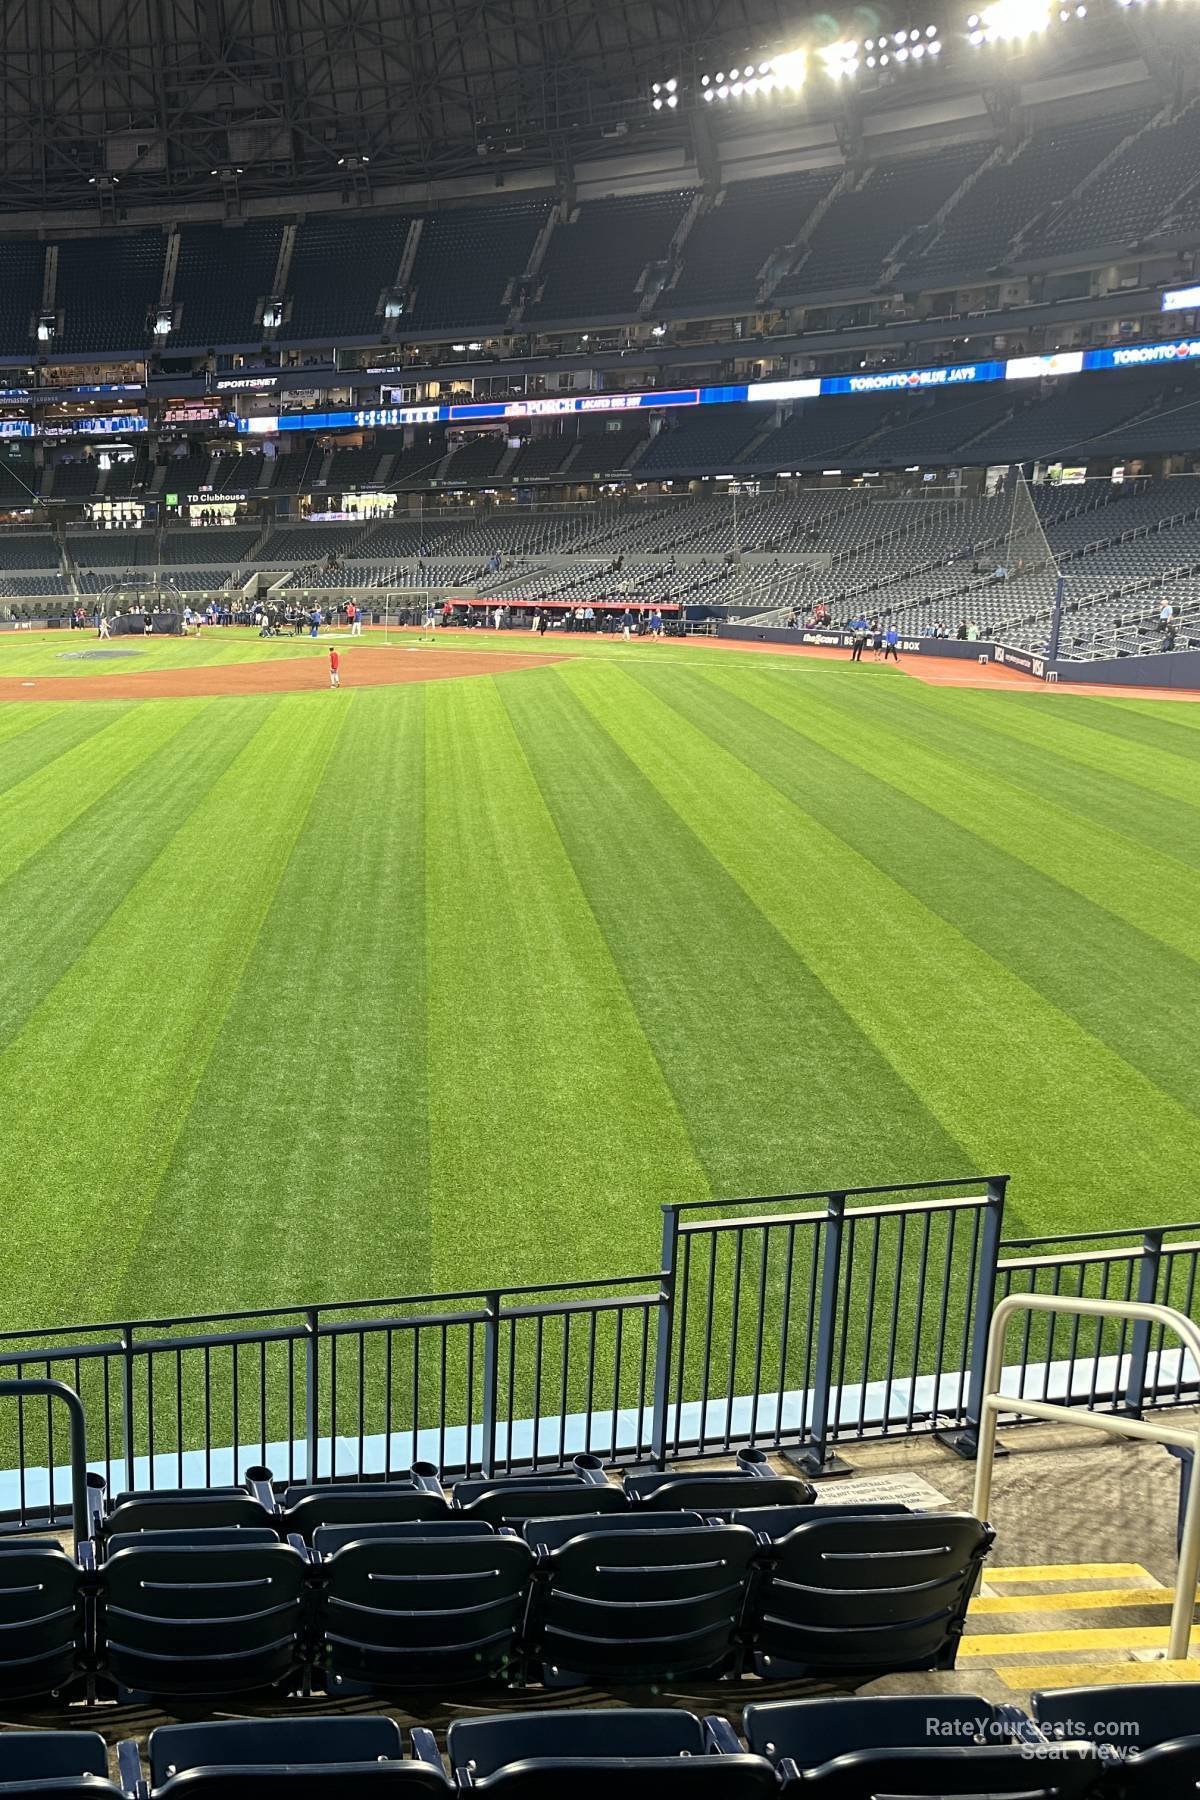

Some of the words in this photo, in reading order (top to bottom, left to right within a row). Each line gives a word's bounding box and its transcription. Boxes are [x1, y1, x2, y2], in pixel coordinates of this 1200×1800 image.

[1113, 345, 1176, 364] TORONTO
[217, 378, 277, 389] SPORTSNET
[849, 374, 908, 391] TORONTO
[919, 370, 946, 384] BLUE
[947, 367, 976, 381] JAYS
[527, 400, 576, 415] PORCH
[187, 495, 199, 503] TD
[200, 494, 245, 502] Clubhouse
[803, 633, 839, 645] theScore
[844, 636, 856, 646] BE
[904, 641, 920, 651] BOX
[994, 646, 1004, 662] VISA
[1032, 658, 1044, 677] VISA
